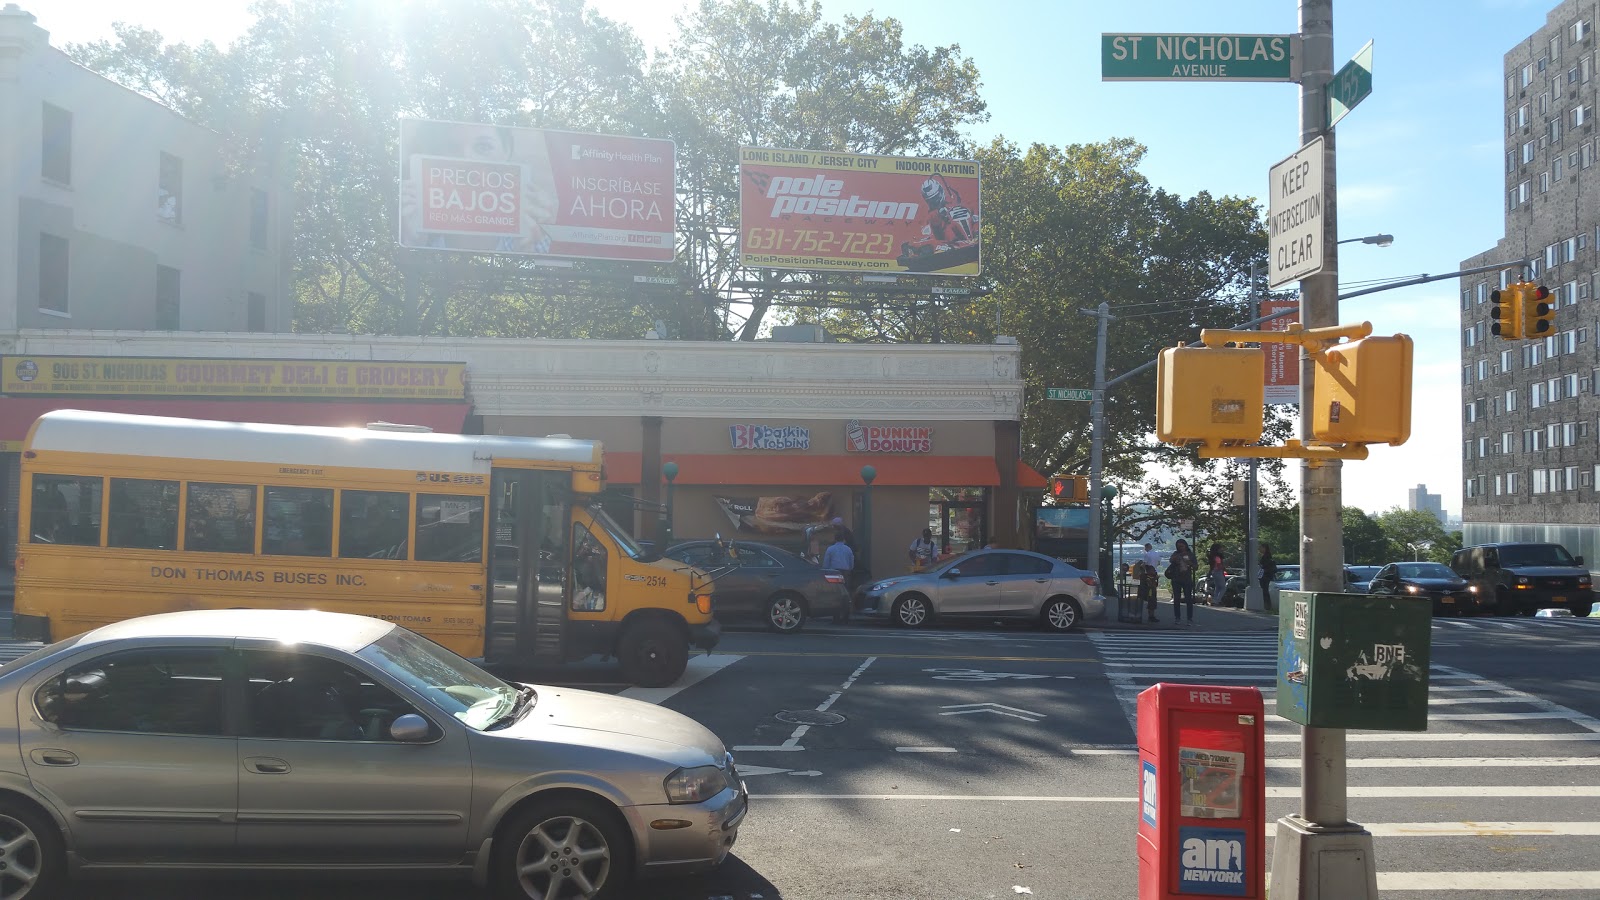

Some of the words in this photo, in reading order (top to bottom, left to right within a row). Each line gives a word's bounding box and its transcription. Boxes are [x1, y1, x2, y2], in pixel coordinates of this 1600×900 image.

[1112, 37, 1142, 61] ST
[1156, 37, 1285, 61] NICHOLAS
[1172, 64, 1227, 77] AVENUE
[582, 148, 614, 162] Affinity
[615, 151, 642, 163] Health
[644, 153, 662, 165] Plan
[742, 151, 769, 163] LONG
[772, 152, 809, 165] ISLAND
[817, 155, 854, 168] JERSEY
[857, 157, 878, 169] CITY
[895, 160, 931, 173] INDOOR
[933, 162, 975, 175] KARTING
[430, 167, 515, 190] PRECIOS
[571, 176, 663, 196] INSCRÍBASE
[767, 174, 844, 199] pole
[1281, 160, 1310, 199] KEEP
[429, 187, 516, 214] BAJOS
[570, 195, 663, 222] AHORA
[770, 195, 919, 220] position
[429, 211, 450, 222] RED
[474, 213, 516, 226] GRANDE
[780, 214, 914, 226] RACEWAY
[1271, 192, 1321, 238] INTERSECTION
[746, 227, 894, 255] 631-752-7223
[1278, 233, 1313, 272] CLEAR
[744, 254, 890, 269] PolePositionRaceway.com
[1270, 344, 1278, 383] Storytelling
[52, 362, 80, 380] 906
[82, 363, 101, 380] ST.
[103, 363, 168, 381] NICHOLAS
[175, 363, 276, 384] GOURMET
[282, 365, 329, 385] DELI
[336, 367, 350, 385] &
[356, 367, 448, 387] GROCERY
[1048, 389, 1057, 398] ST
[1058, 389, 1087, 400] NICHOLAS
[763, 425, 809, 438] baskin
[870, 427, 933, 439] DUNKIN'
[764, 437, 809, 449] robbins
[870, 439, 930, 451] DONUTS
[279, 467, 310, 475] EMERGENCY
[311, 468, 323, 476] EXIT
[454, 474, 484, 485] BUS
[150, 566, 187, 579] DON
[195, 568, 265, 583] THOMAS
[273, 571, 327, 586] BUSES
[336, 573, 368, 587] INC.
[646, 575, 667, 587] 2514
[381, 614, 401, 622] DON
[403, 615, 432, 623] TOMAS
[1376, 646, 1403, 664] BNE
[1189, 691, 1233, 705] FREE
[1182, 837, 1242, 872] am
[1183, 869, 1243, 884] NEWYORK
